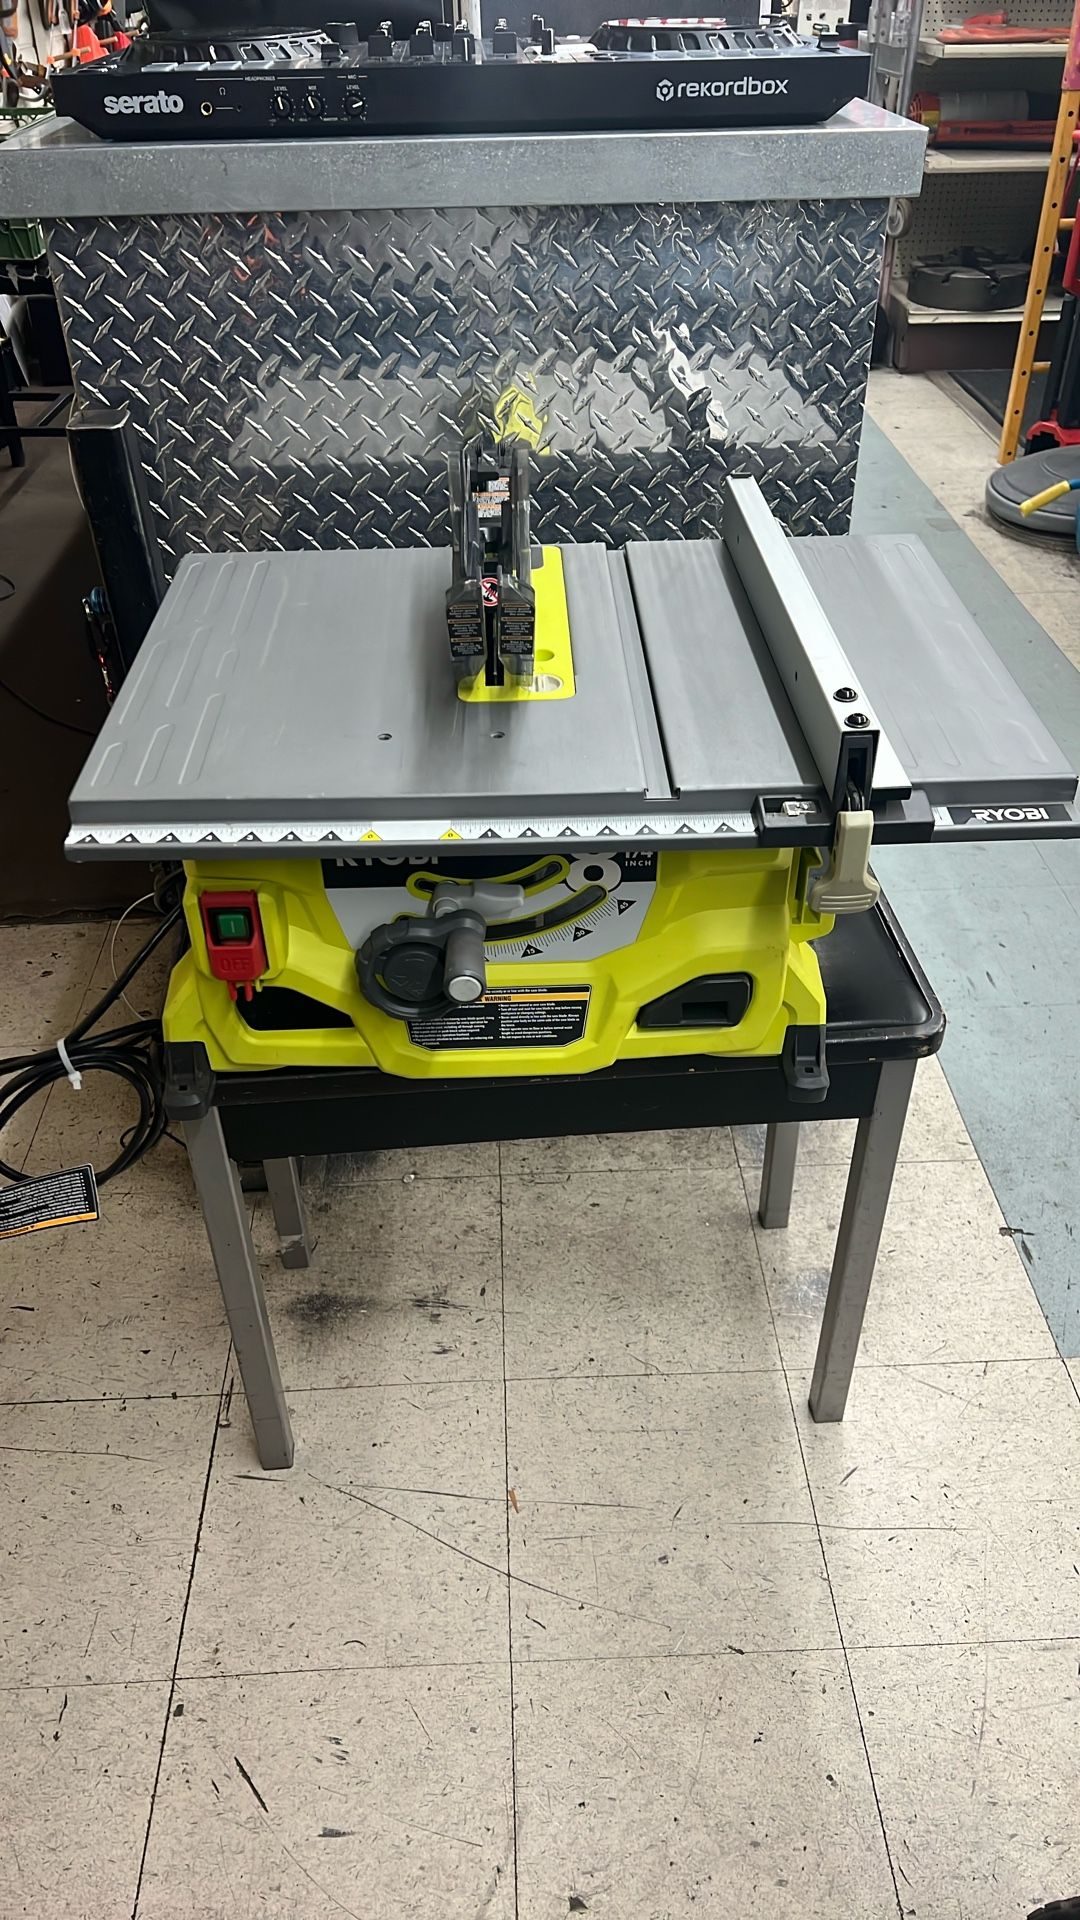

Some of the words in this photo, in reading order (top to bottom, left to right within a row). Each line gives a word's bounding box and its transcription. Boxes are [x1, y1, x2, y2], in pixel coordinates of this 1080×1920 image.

[677, 76, 789, 98] rekordbox
[103, 90, 184, 115] serato
[971, 808, 1050, 821] RYOBI
